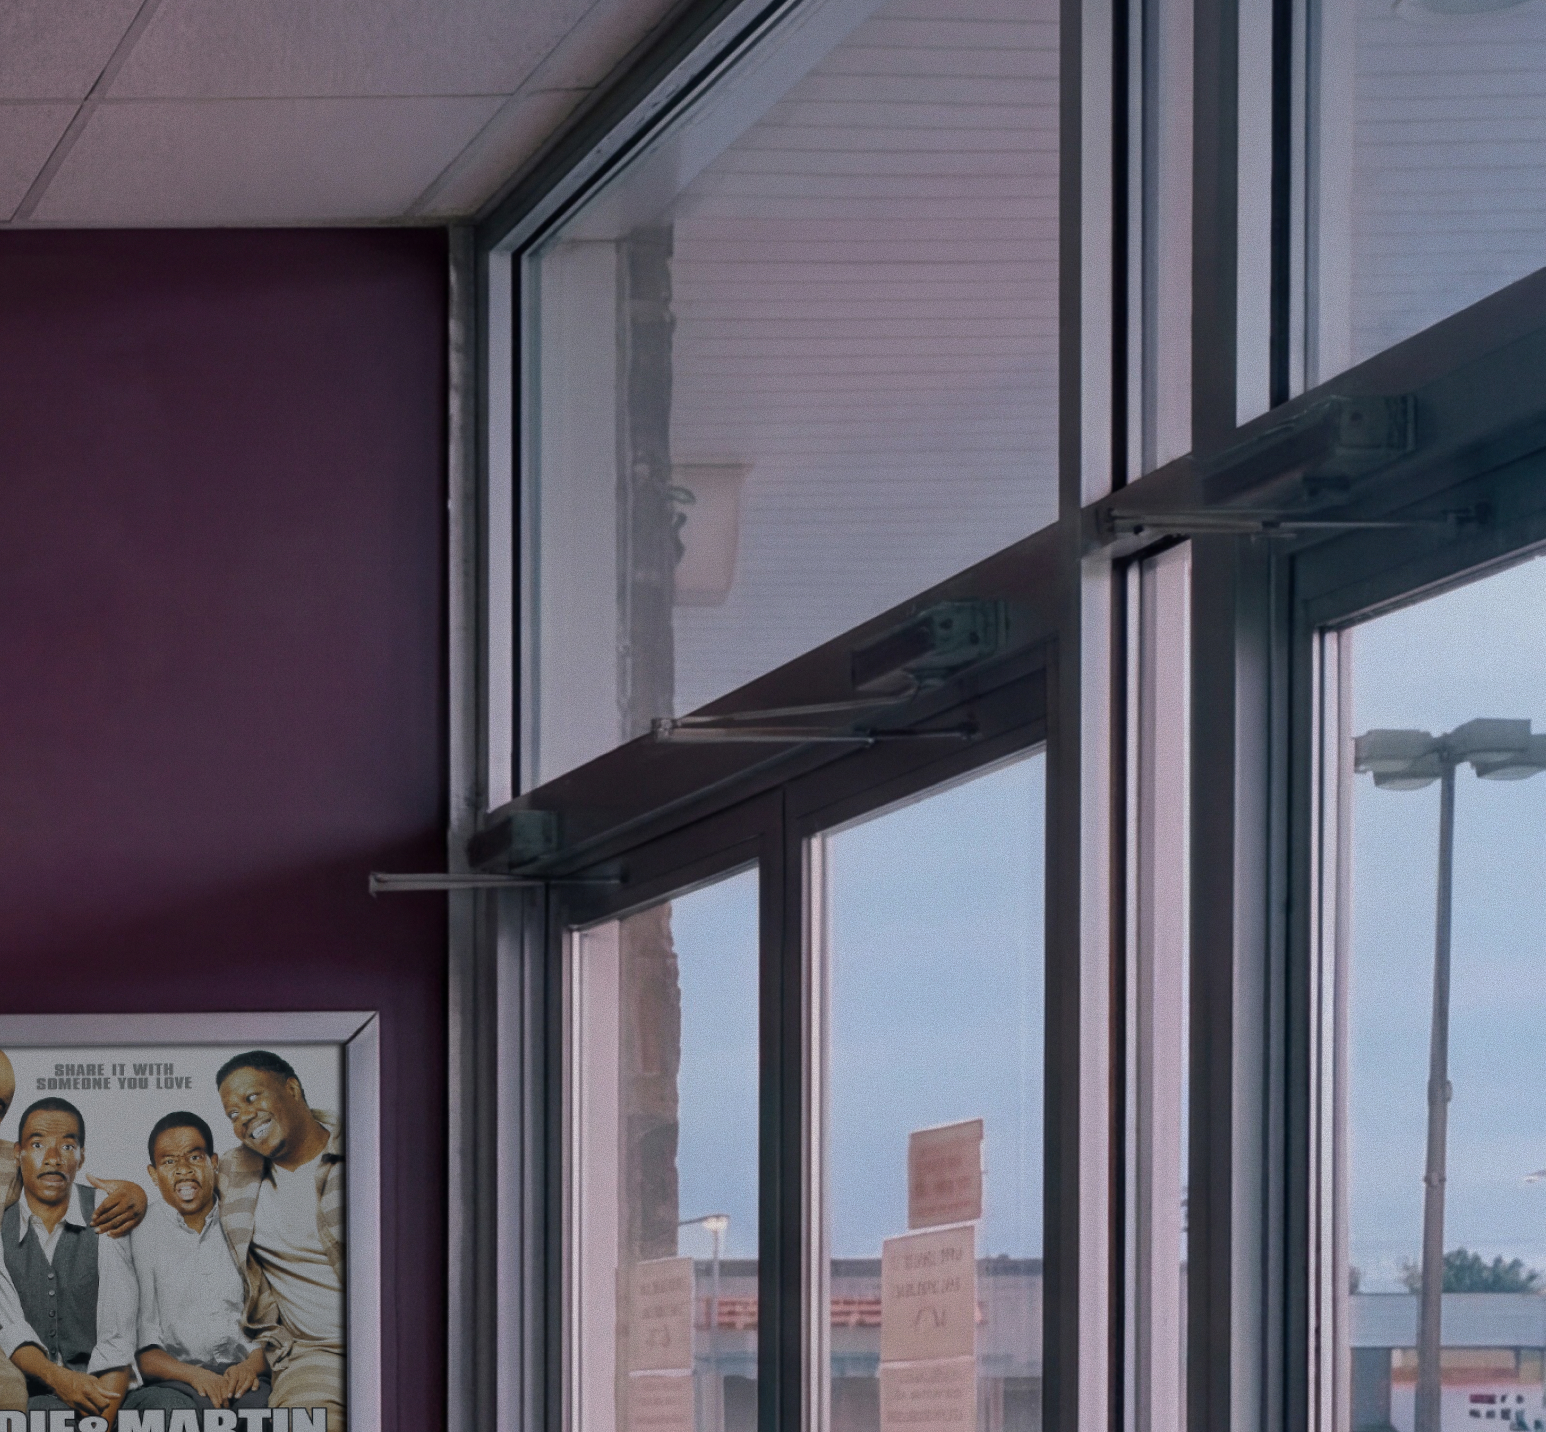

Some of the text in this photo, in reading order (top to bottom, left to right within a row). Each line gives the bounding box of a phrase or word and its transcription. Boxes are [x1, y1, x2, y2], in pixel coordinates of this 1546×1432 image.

[54, 1063, 174, 1077] SHARE IT WITH
[36, 1076, 193, 1090] SOMEONE YOU LOVE
